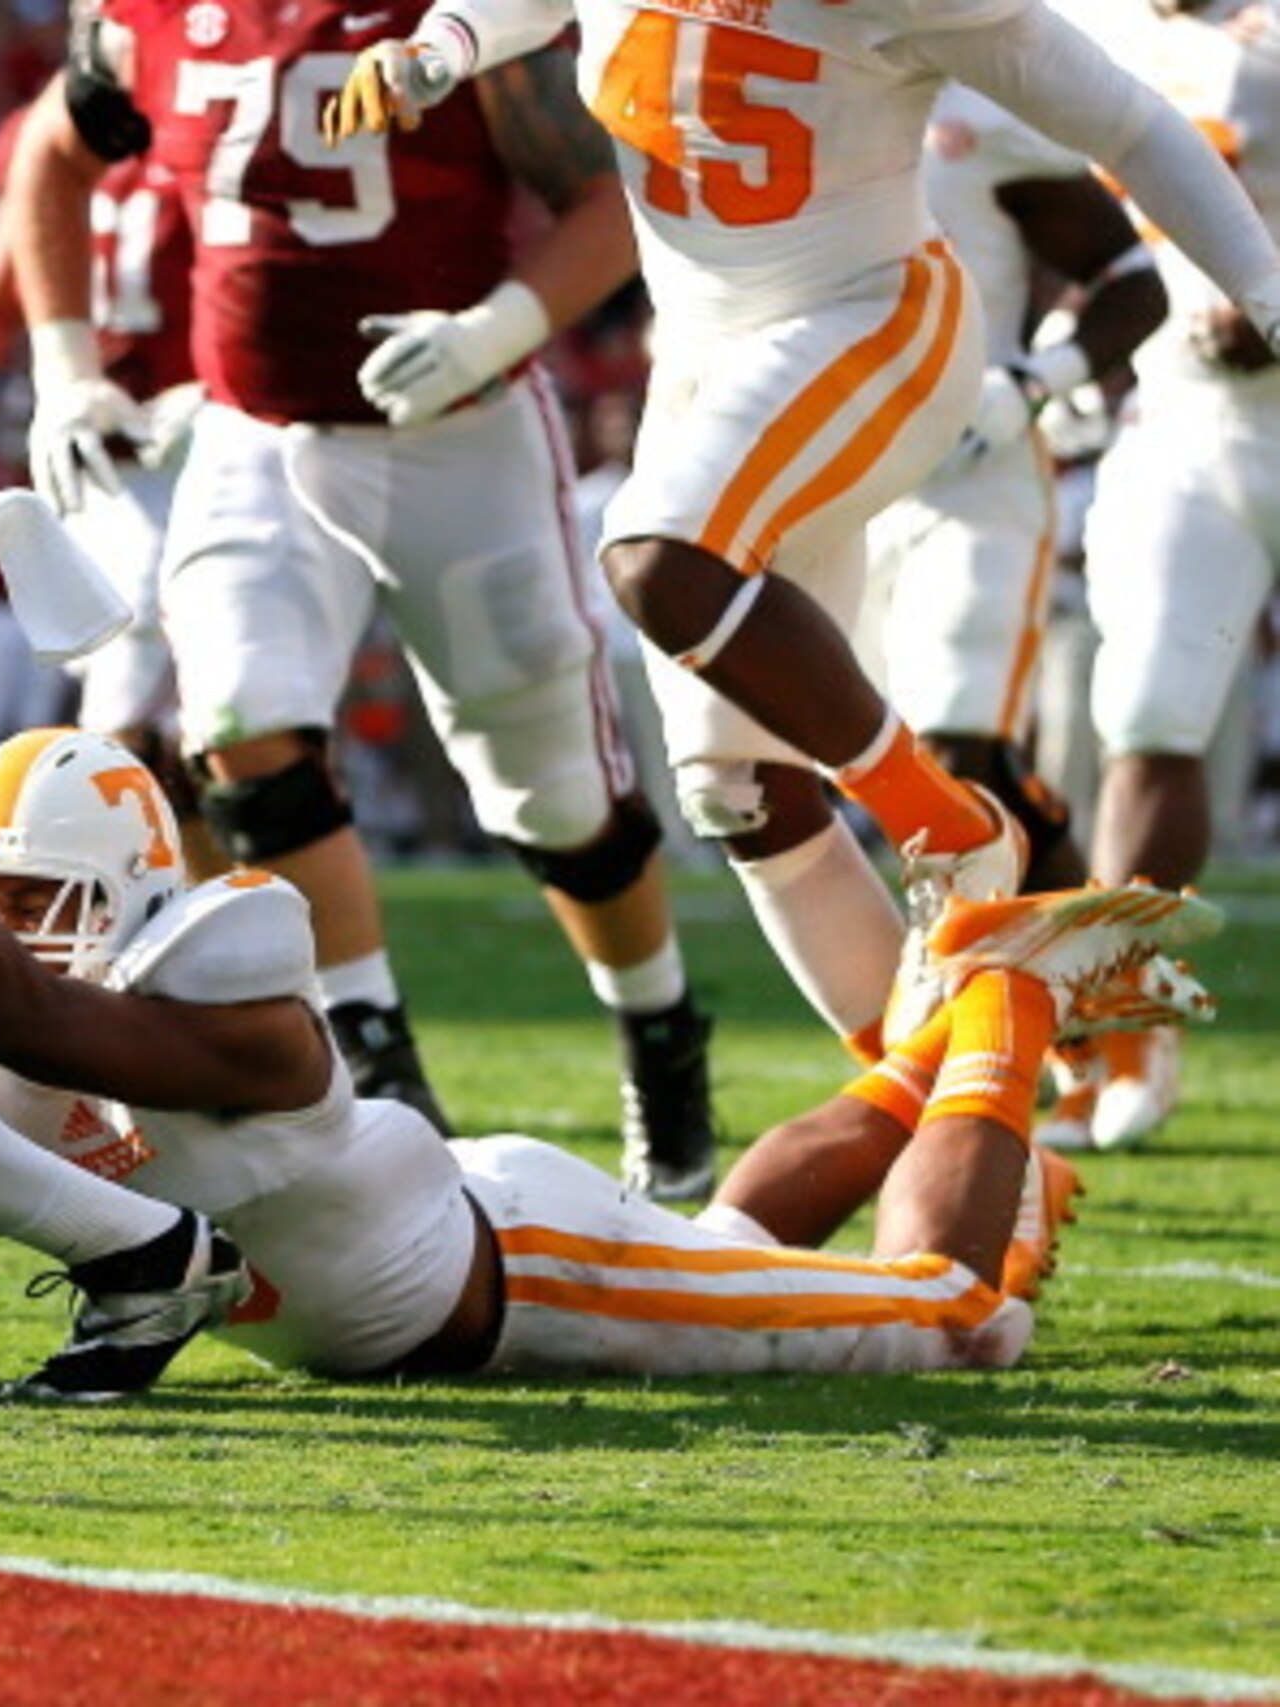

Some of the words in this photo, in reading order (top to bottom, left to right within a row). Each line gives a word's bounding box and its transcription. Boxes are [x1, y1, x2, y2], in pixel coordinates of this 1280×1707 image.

[174, 53, 396, 246] 79
[594, 8, 821, 228] 45
[89, 765, 175, 869] T
